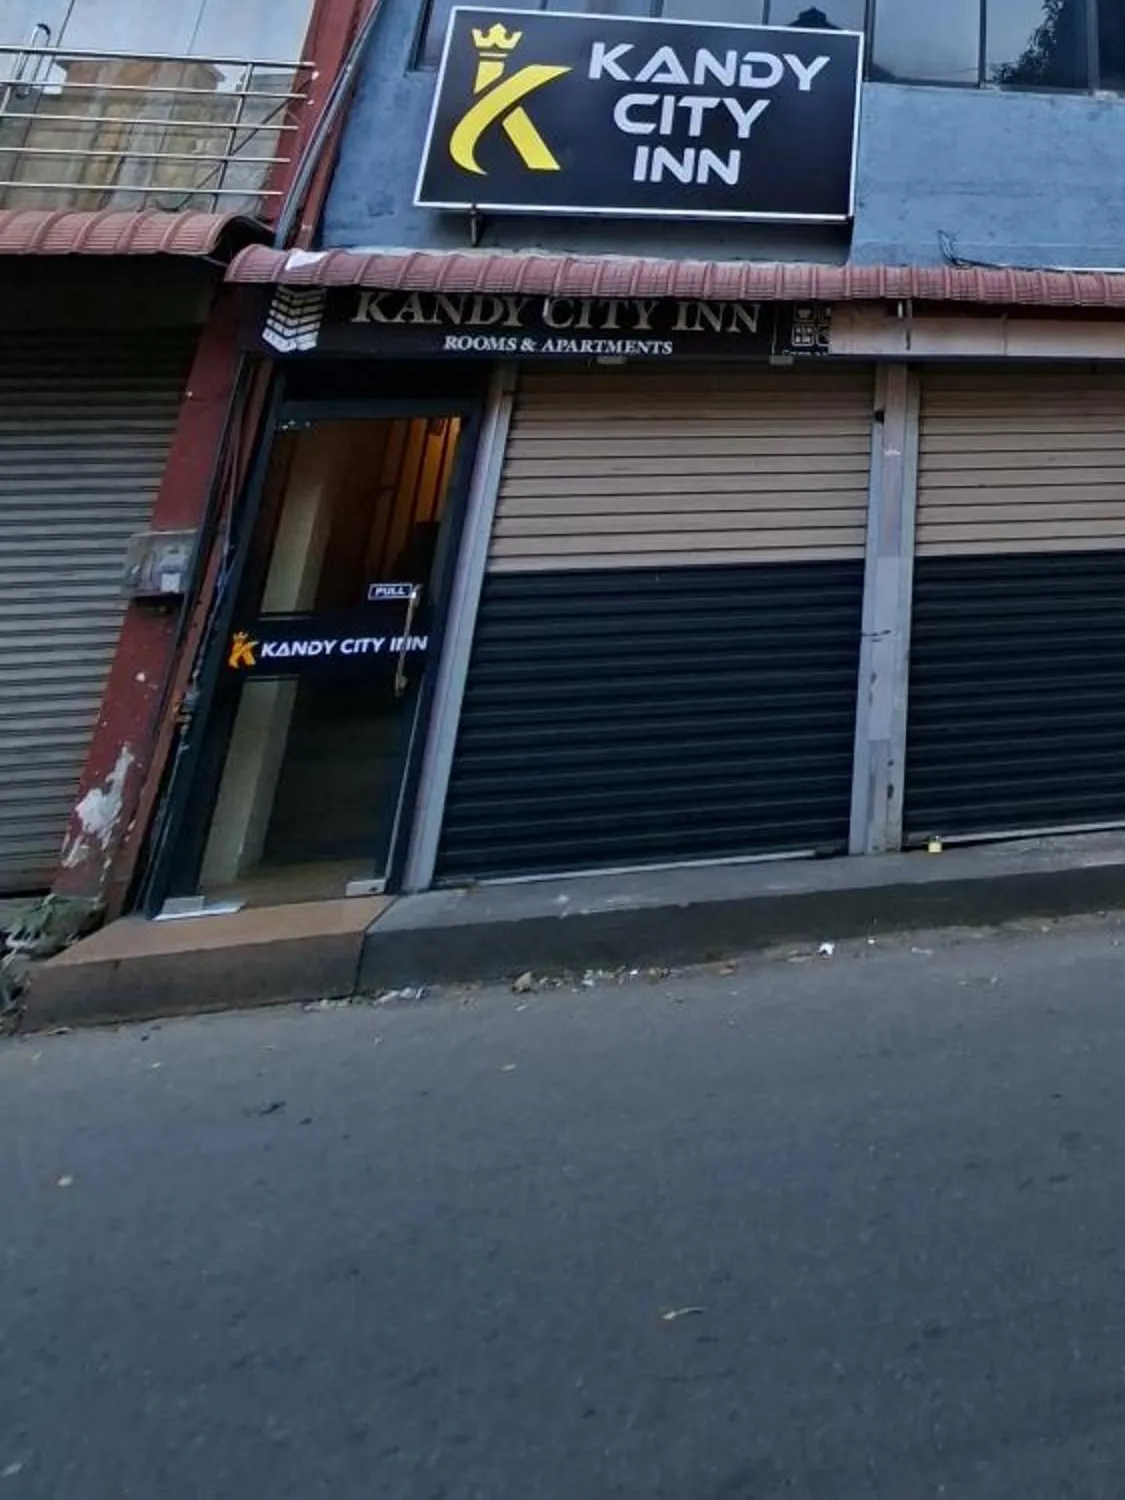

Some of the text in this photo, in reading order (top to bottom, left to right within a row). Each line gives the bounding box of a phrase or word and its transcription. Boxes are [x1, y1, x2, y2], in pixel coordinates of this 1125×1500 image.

[588, 41, 831, 91] KANDY
[613, 93, 771, 138] CITY
[633, 145, 741, 185] INN
[351, 291, 761, 334] KANDY CITY INN
[444, 335, 673, 355] ROOMS & APARTMENTS
[374, 586, 405, 597] PULL
[261, 640, 337, 658] KANDY
[340, 637, 387, 655] CITY
